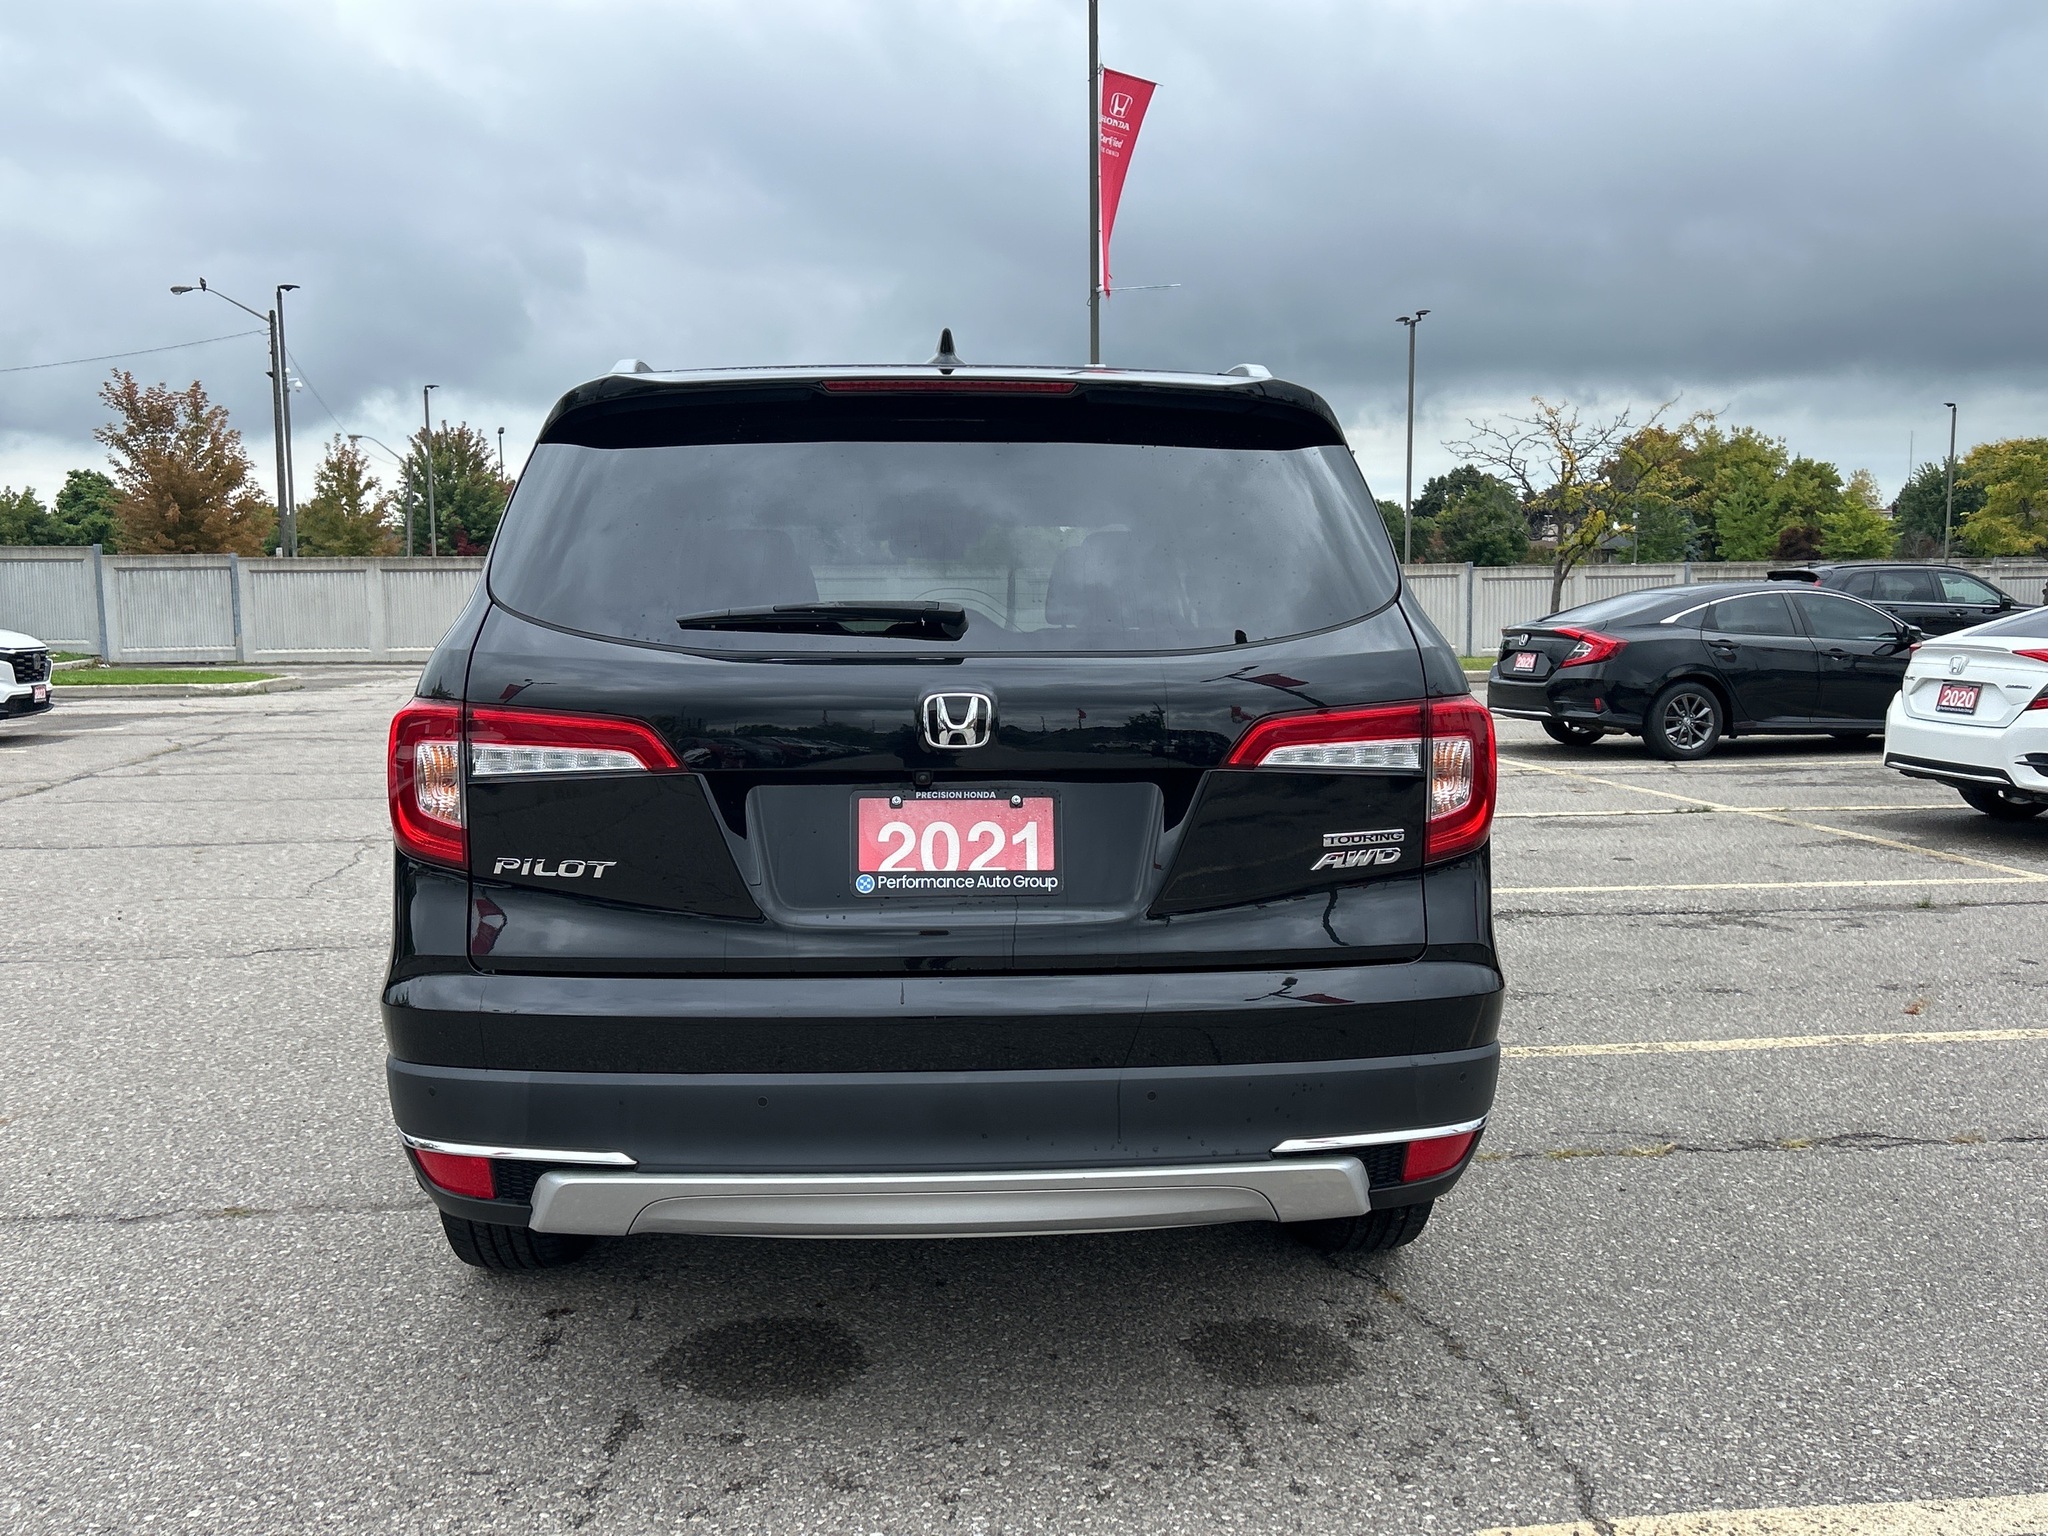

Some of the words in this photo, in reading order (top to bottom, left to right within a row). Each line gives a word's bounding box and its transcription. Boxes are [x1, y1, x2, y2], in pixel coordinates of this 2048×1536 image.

[1941, 690, 1975, 707] 2020
[916, 791, 962, 799] PRECISION
[963, 791, 996, 799] HONDA
[877, 821, 1038, 872] 2021
[1325, 831, 1404, 846] TOURING
[1310, 847, 1401, 870] AWD
[493, 857, 617, 878] PILOT
[877, 874, 974, 889] Performance
[977, 875, 1011, 888] Auto
[1013, 875, 1058, 891] Group
